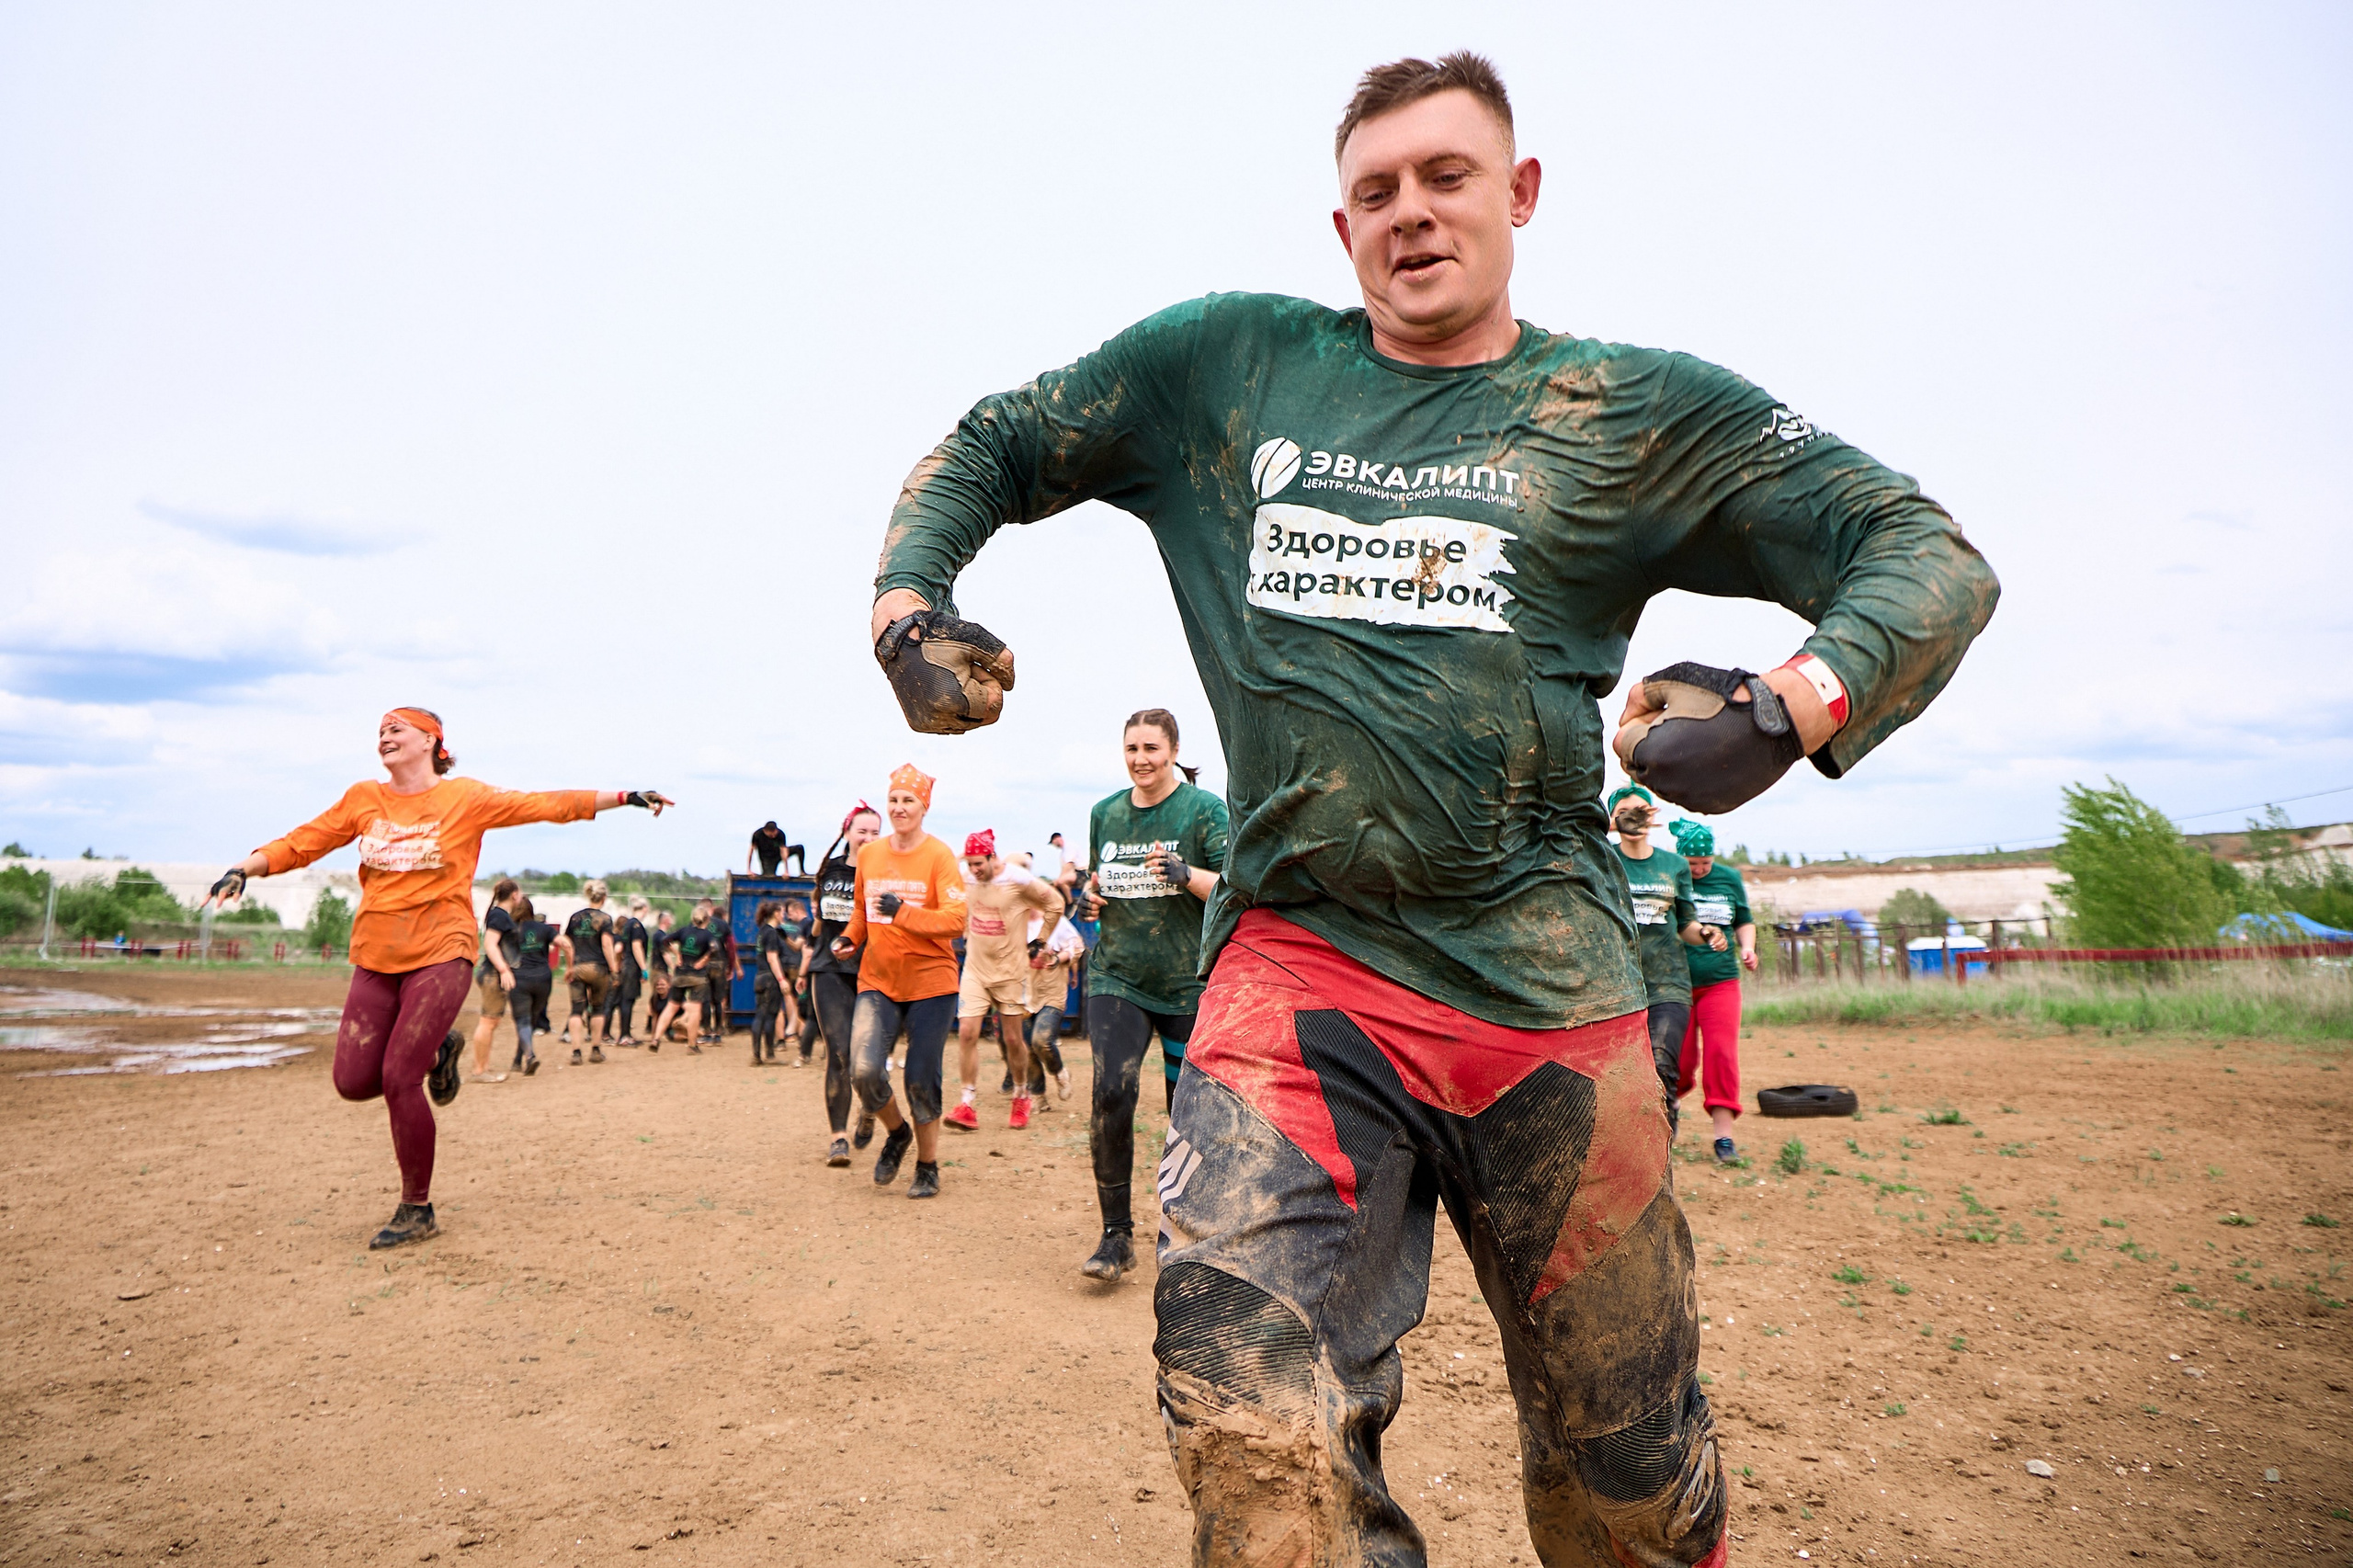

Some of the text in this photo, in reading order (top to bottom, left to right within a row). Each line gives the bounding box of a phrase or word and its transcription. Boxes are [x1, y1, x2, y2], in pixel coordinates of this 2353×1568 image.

[1303, 450, 1520, 494] ЭВКАЛИПТ
[1302, 478, 1518, 508] ЦЕНТР КЛИНИЧЕСКОЙ МЕДИЦИНЫ
[1267, 523, 1467, 562] Здоровье
[1258, 571, 1495, 612] характером
[1108, 881, 1175, 894] характером
